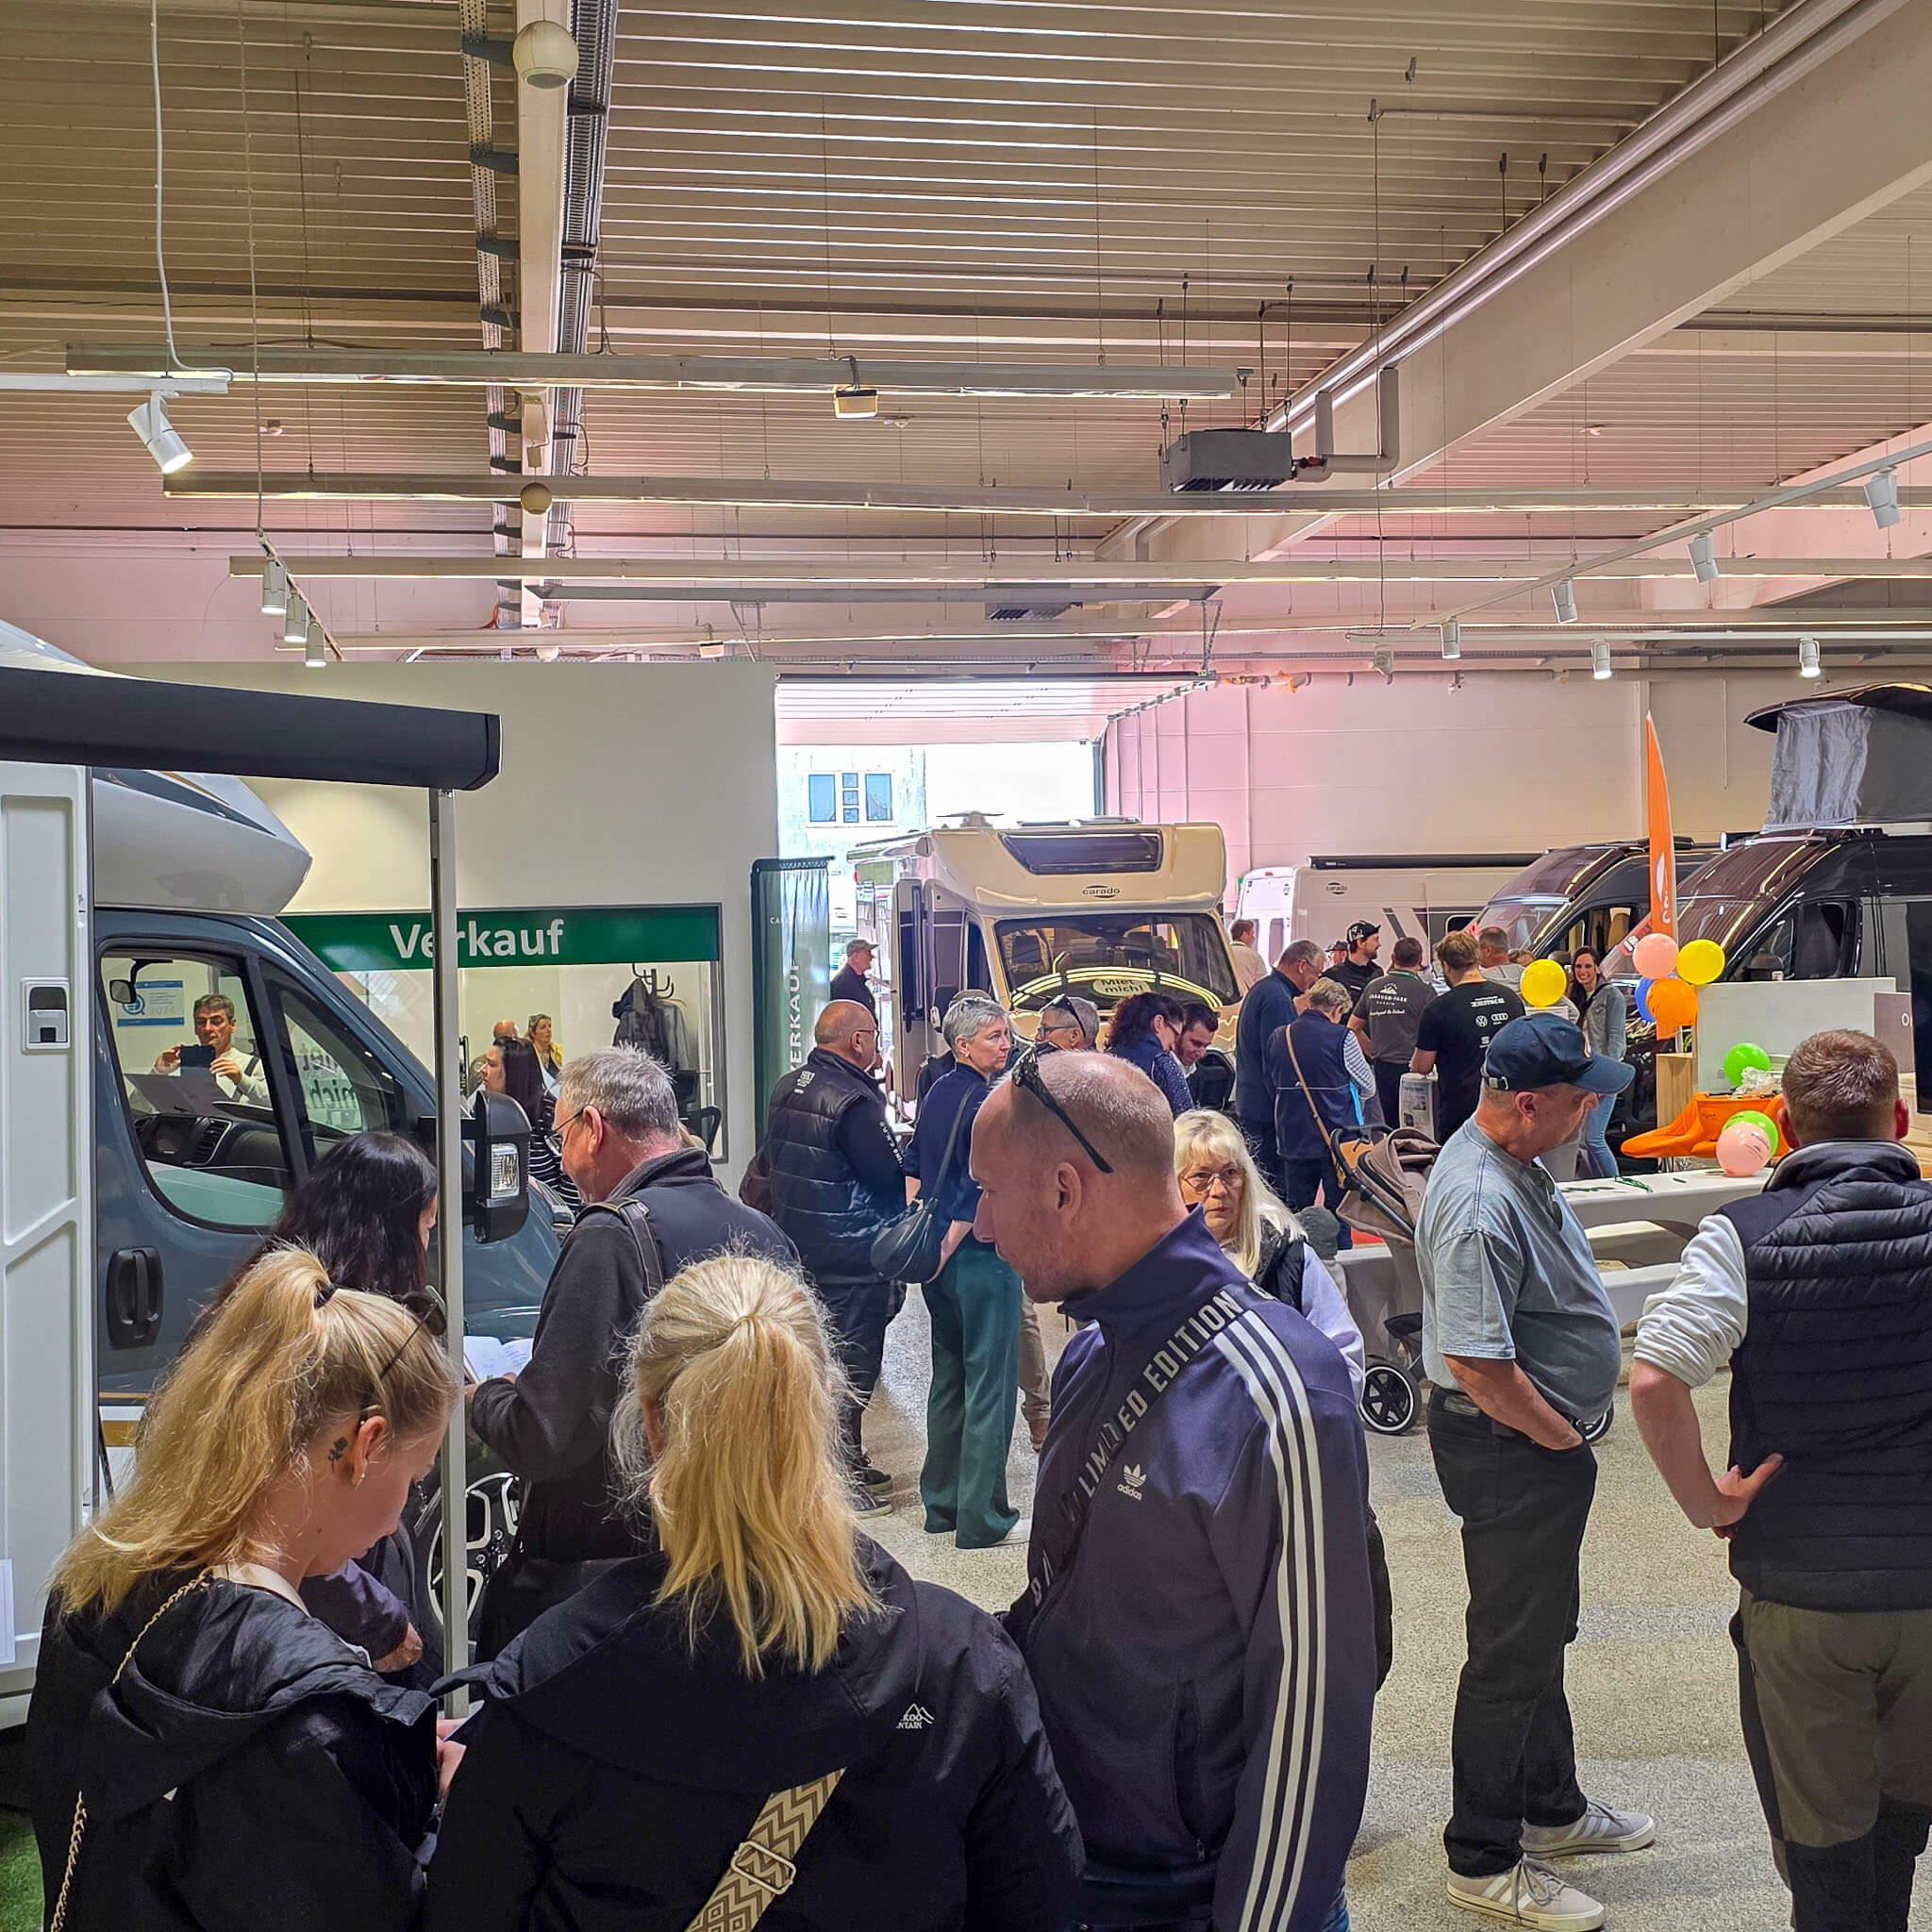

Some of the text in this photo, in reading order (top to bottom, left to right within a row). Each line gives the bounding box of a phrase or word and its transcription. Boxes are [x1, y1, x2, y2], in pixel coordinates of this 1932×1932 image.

[1078, 1290, 1244, 1498] LIMITED EDITION
[1117, 1484, 1142, 1501] adidas
